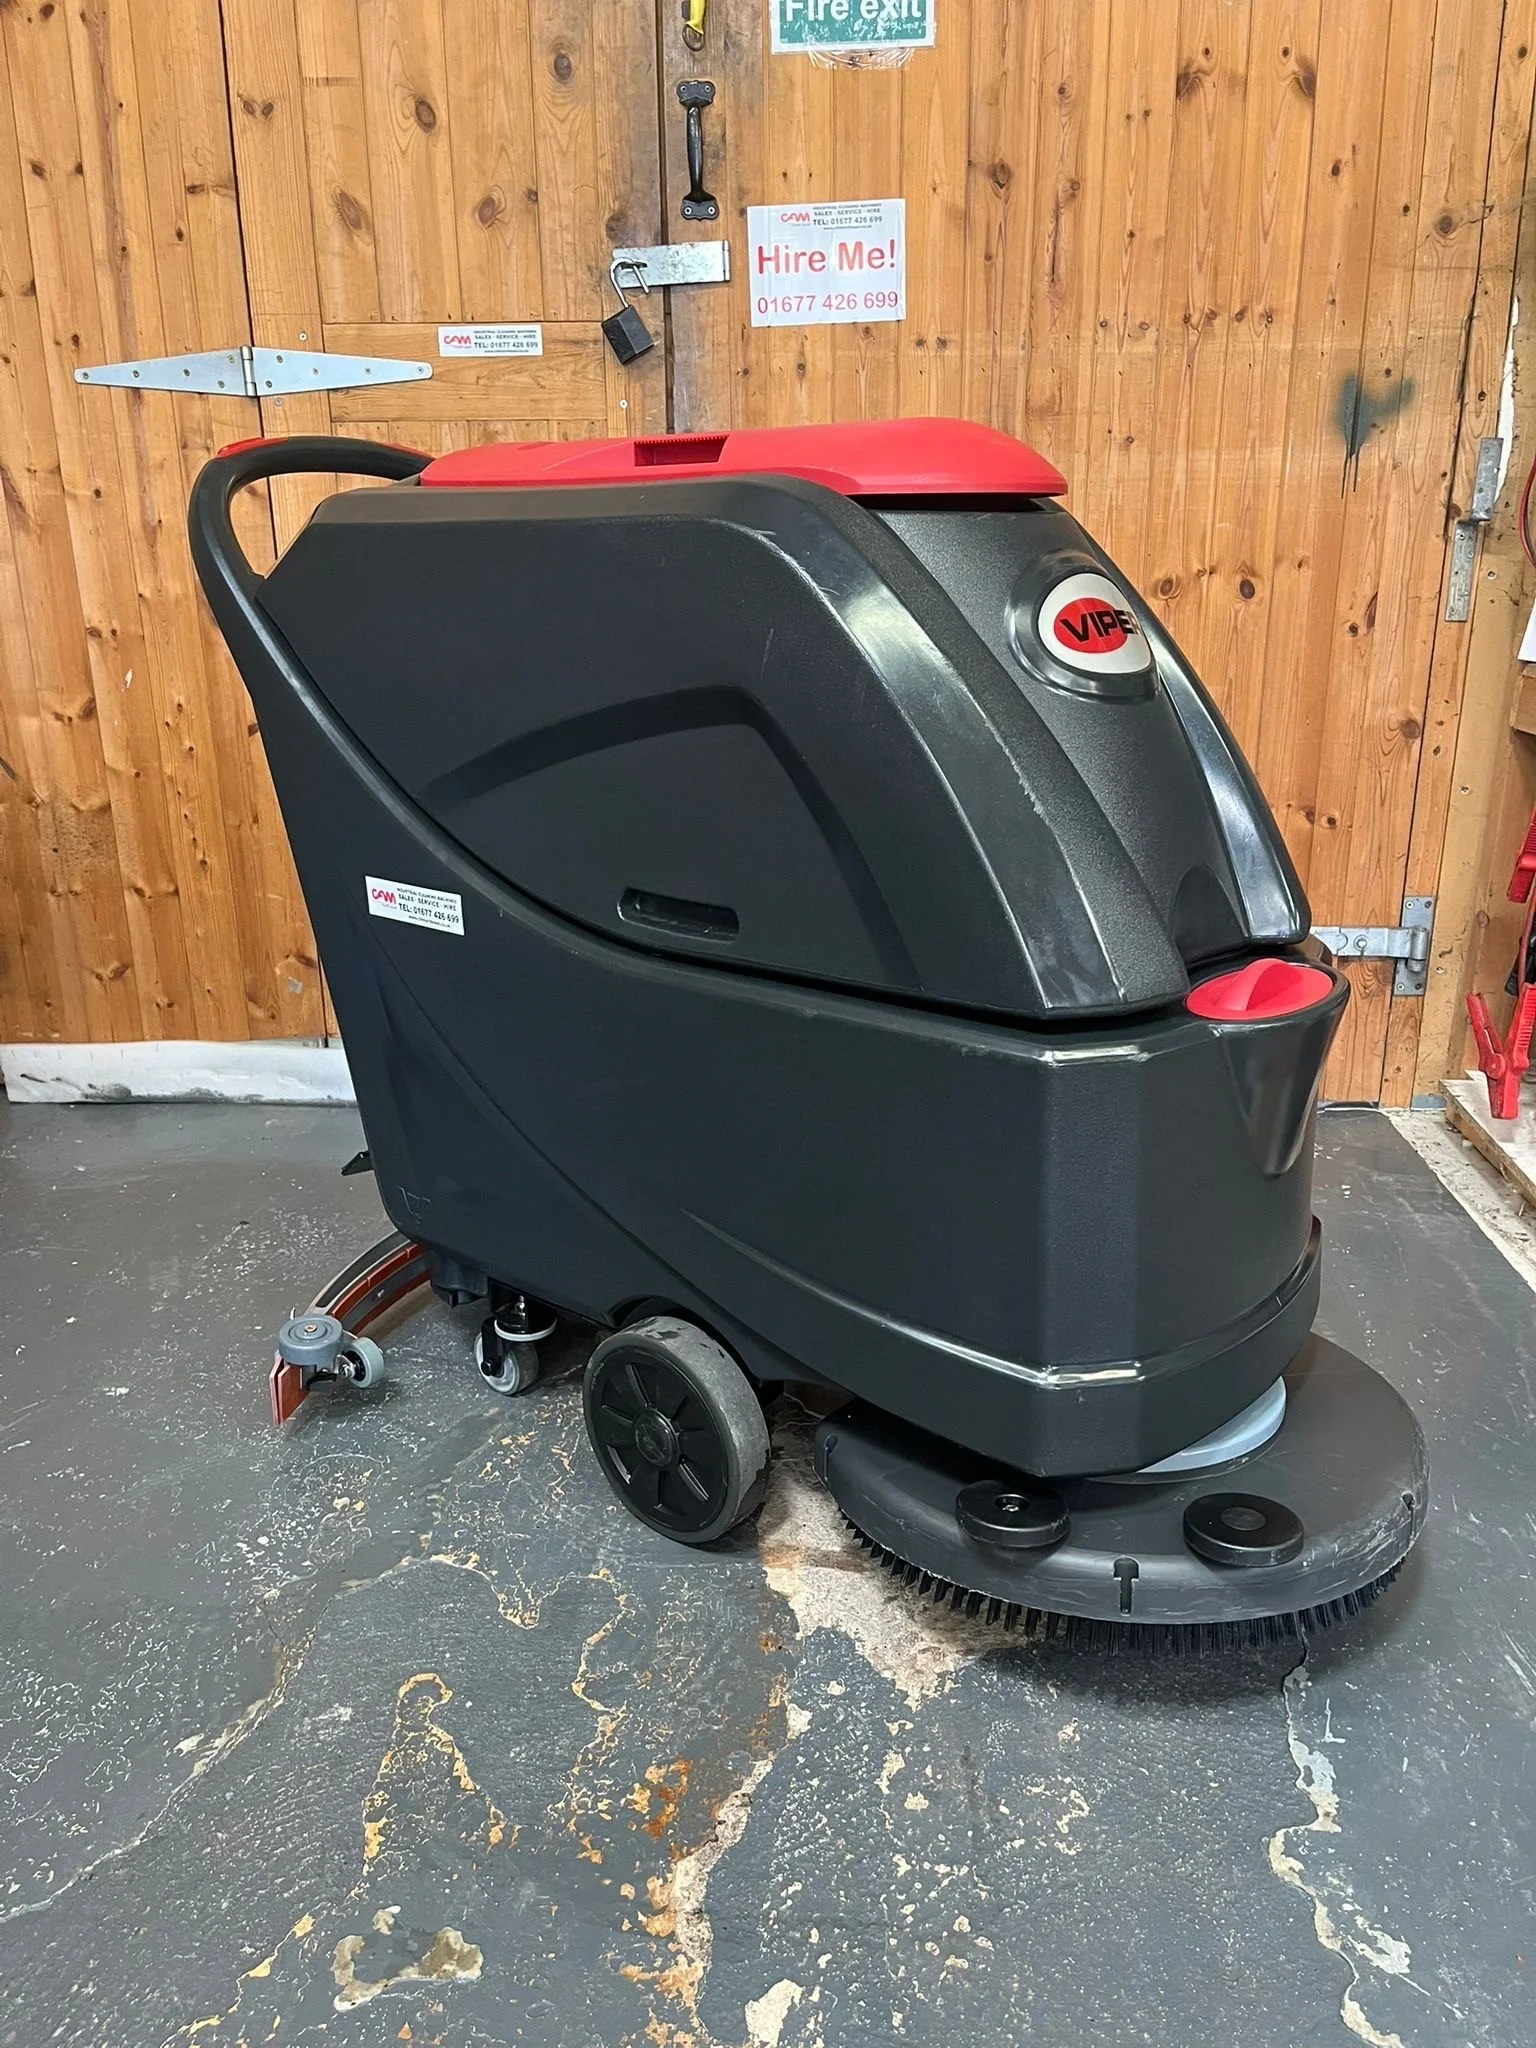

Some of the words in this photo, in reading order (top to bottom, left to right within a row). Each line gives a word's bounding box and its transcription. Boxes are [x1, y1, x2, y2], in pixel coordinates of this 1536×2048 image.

[784, 0, 850, 21] Fire
[860, 0, 922, 20] exit
[831, 217, 852, 225] 01677
[854, 216, 868, 224] 426
[869, 215, 883, 223] 699
[758, 244, 826, 274] Hire
[838, 239, 895, 271] Me!
[758, 295, 816, 314] 01677
[822, 293, 857, 311] 426
[864, 291, 898, 309] 699
[398, 894, 413, 902] SALES
[417, 898, 439, 908] SERVICE
[443, 903, 456, 911] HIRE
[398, 903, 412, 913] TEL:
[413, 906, 432, 917] 01677
[434, 911, 446, 921] 426
[447, 913, 459, 924] 699
